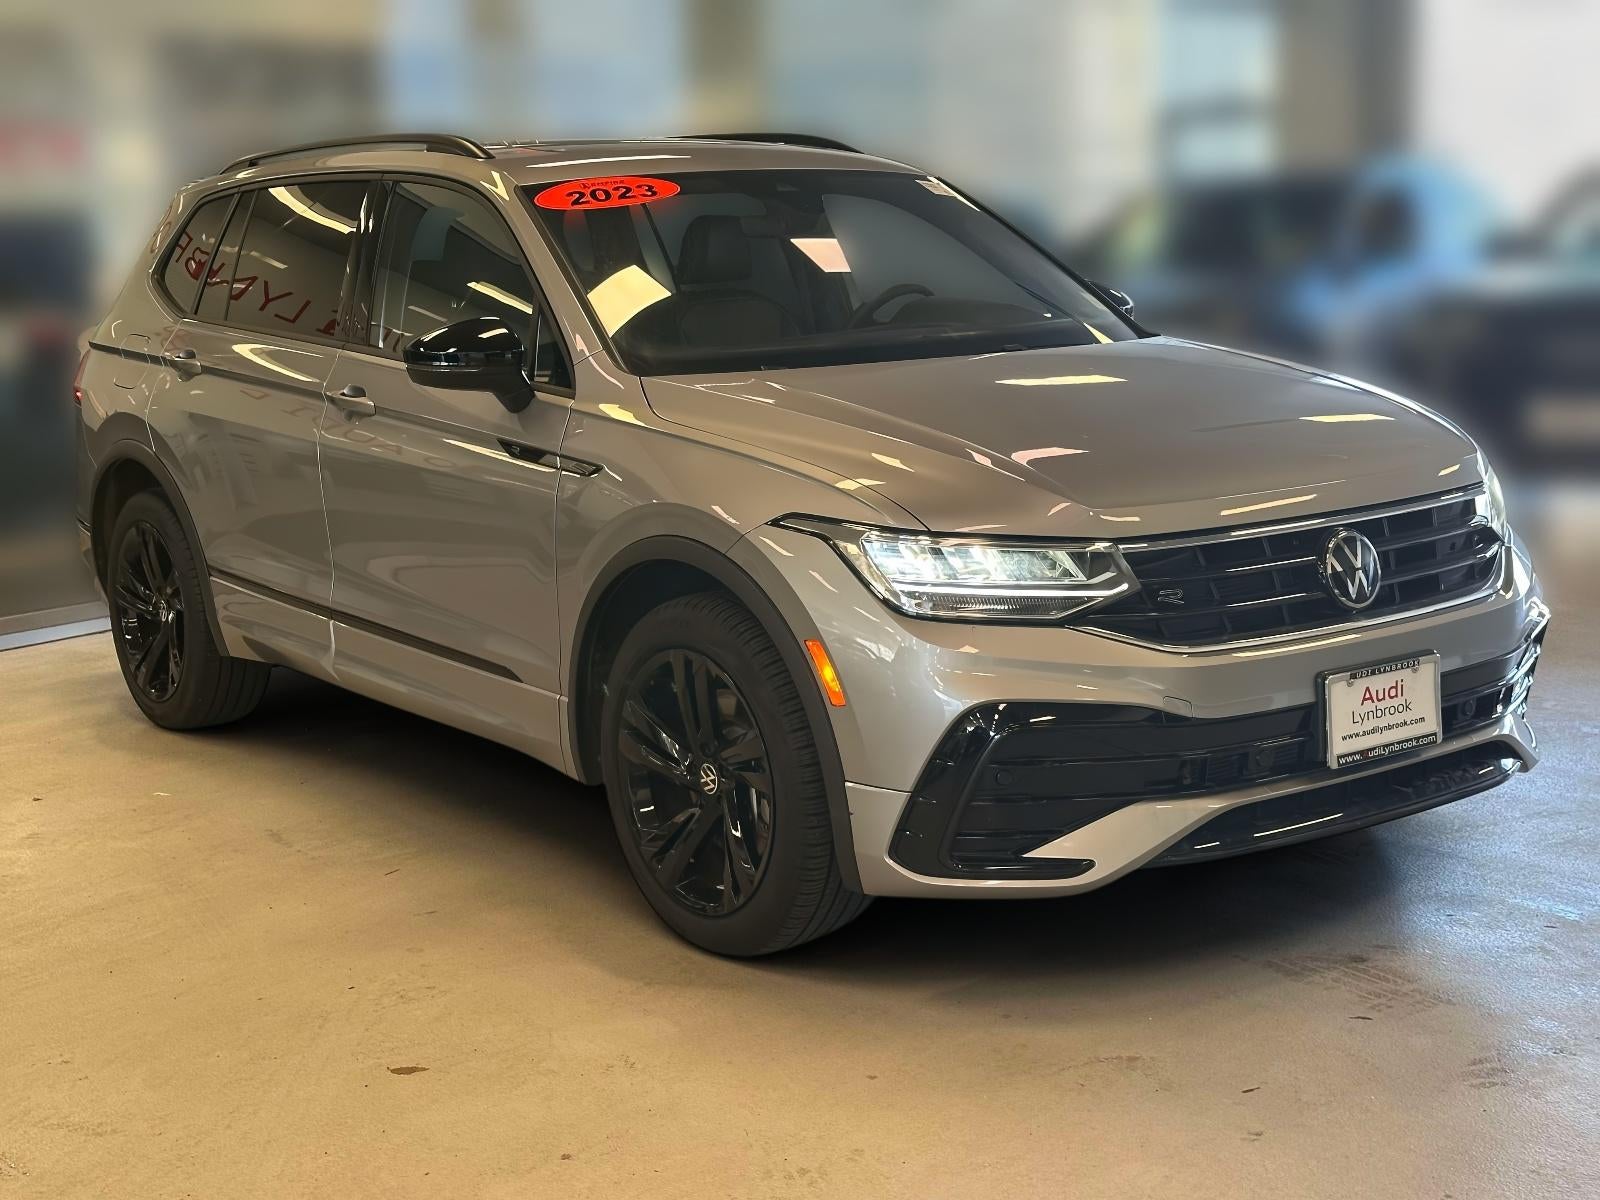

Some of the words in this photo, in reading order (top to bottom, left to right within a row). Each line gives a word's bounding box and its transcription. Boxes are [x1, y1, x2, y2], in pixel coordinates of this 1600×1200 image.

[565, 183, 659, 207] 2023
[1350, 670, 1372, 679] UDI
[1375, 660, 1419, 674] LYNBROOK
[1360, 679, 1404, 706] Audi
[1352, 699, 1412, 726] Lynbrook
[1341, 716, 1426, 741] www.audilynbrook.com
